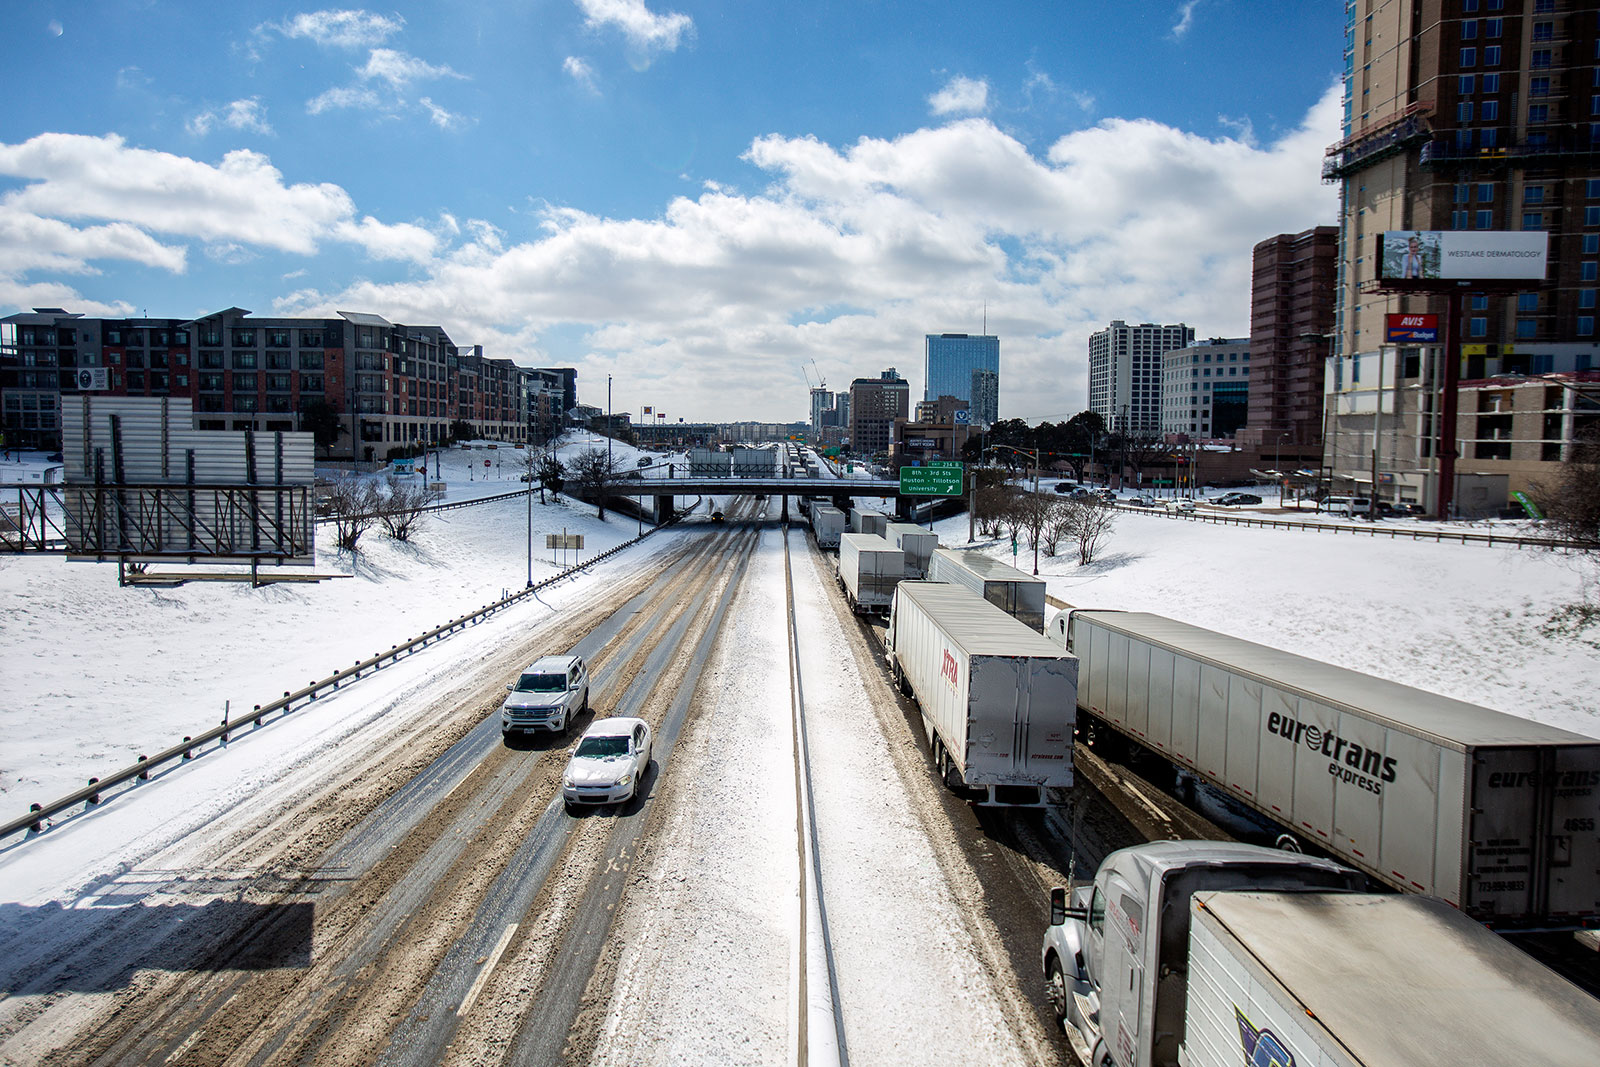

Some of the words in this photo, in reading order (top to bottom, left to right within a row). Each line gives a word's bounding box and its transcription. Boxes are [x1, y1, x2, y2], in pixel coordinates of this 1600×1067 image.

[1447, 250, 1484, 258] WESTLAKE
[1486, 250, 1541, 258] DERMATOLOGY
[1400, 316, 1424, 326] AVIS
[1412, 331, 1434, 340] Budget
[1328, 762, 1382, 795] express
